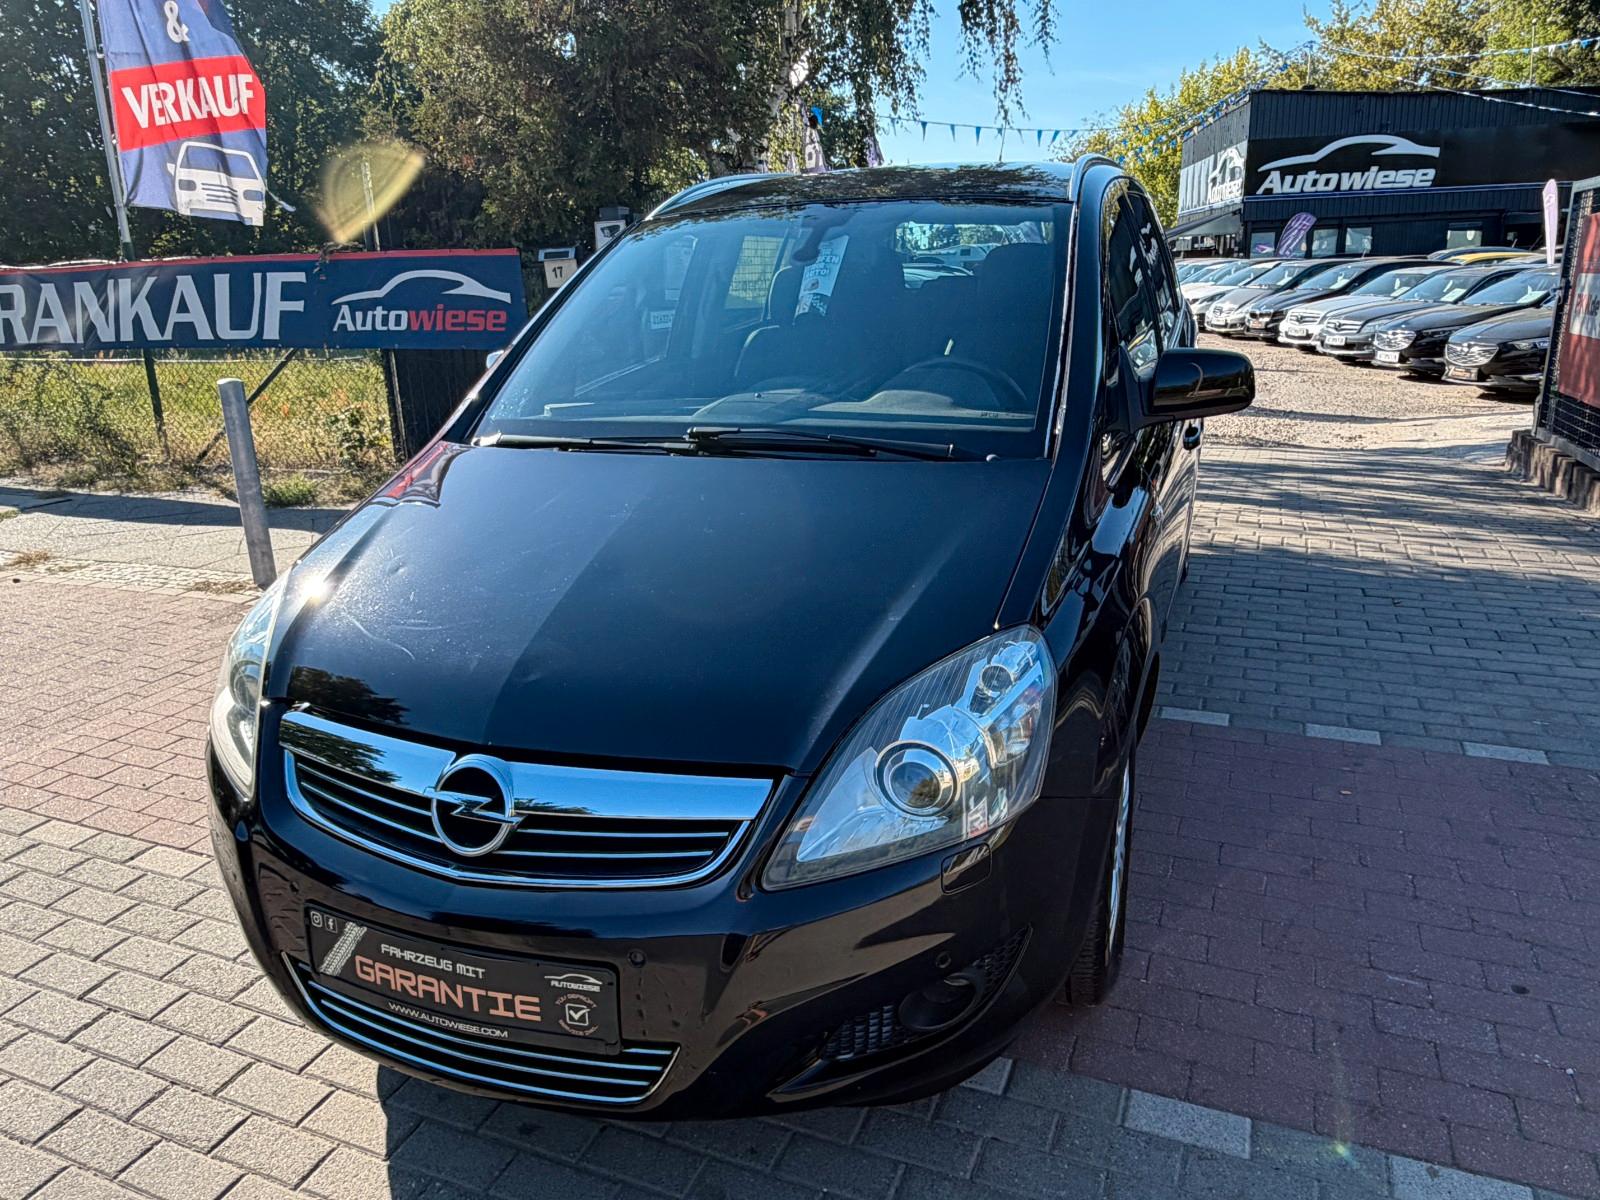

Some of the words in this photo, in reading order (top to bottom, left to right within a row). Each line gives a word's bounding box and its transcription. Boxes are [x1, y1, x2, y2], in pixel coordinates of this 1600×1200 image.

[164, 0, 190, 43] &
[121, 74, 253, 128] VERKAUF
[1256, 166, 1436, 195] Autowiese
[552, 266, 563, 279] 17
[333, 304, 507, 332] Autowiese
[381, 944, 453, 971] FAHRZEUG
[456, 963, 486, 979] MIT
[355, 955, 541, 1021] GARANTIE
[551, 980, 600, 992] AUTOWIESE
[388, 1002, 508, 1038] WWW.AUTOWIESE.COM
